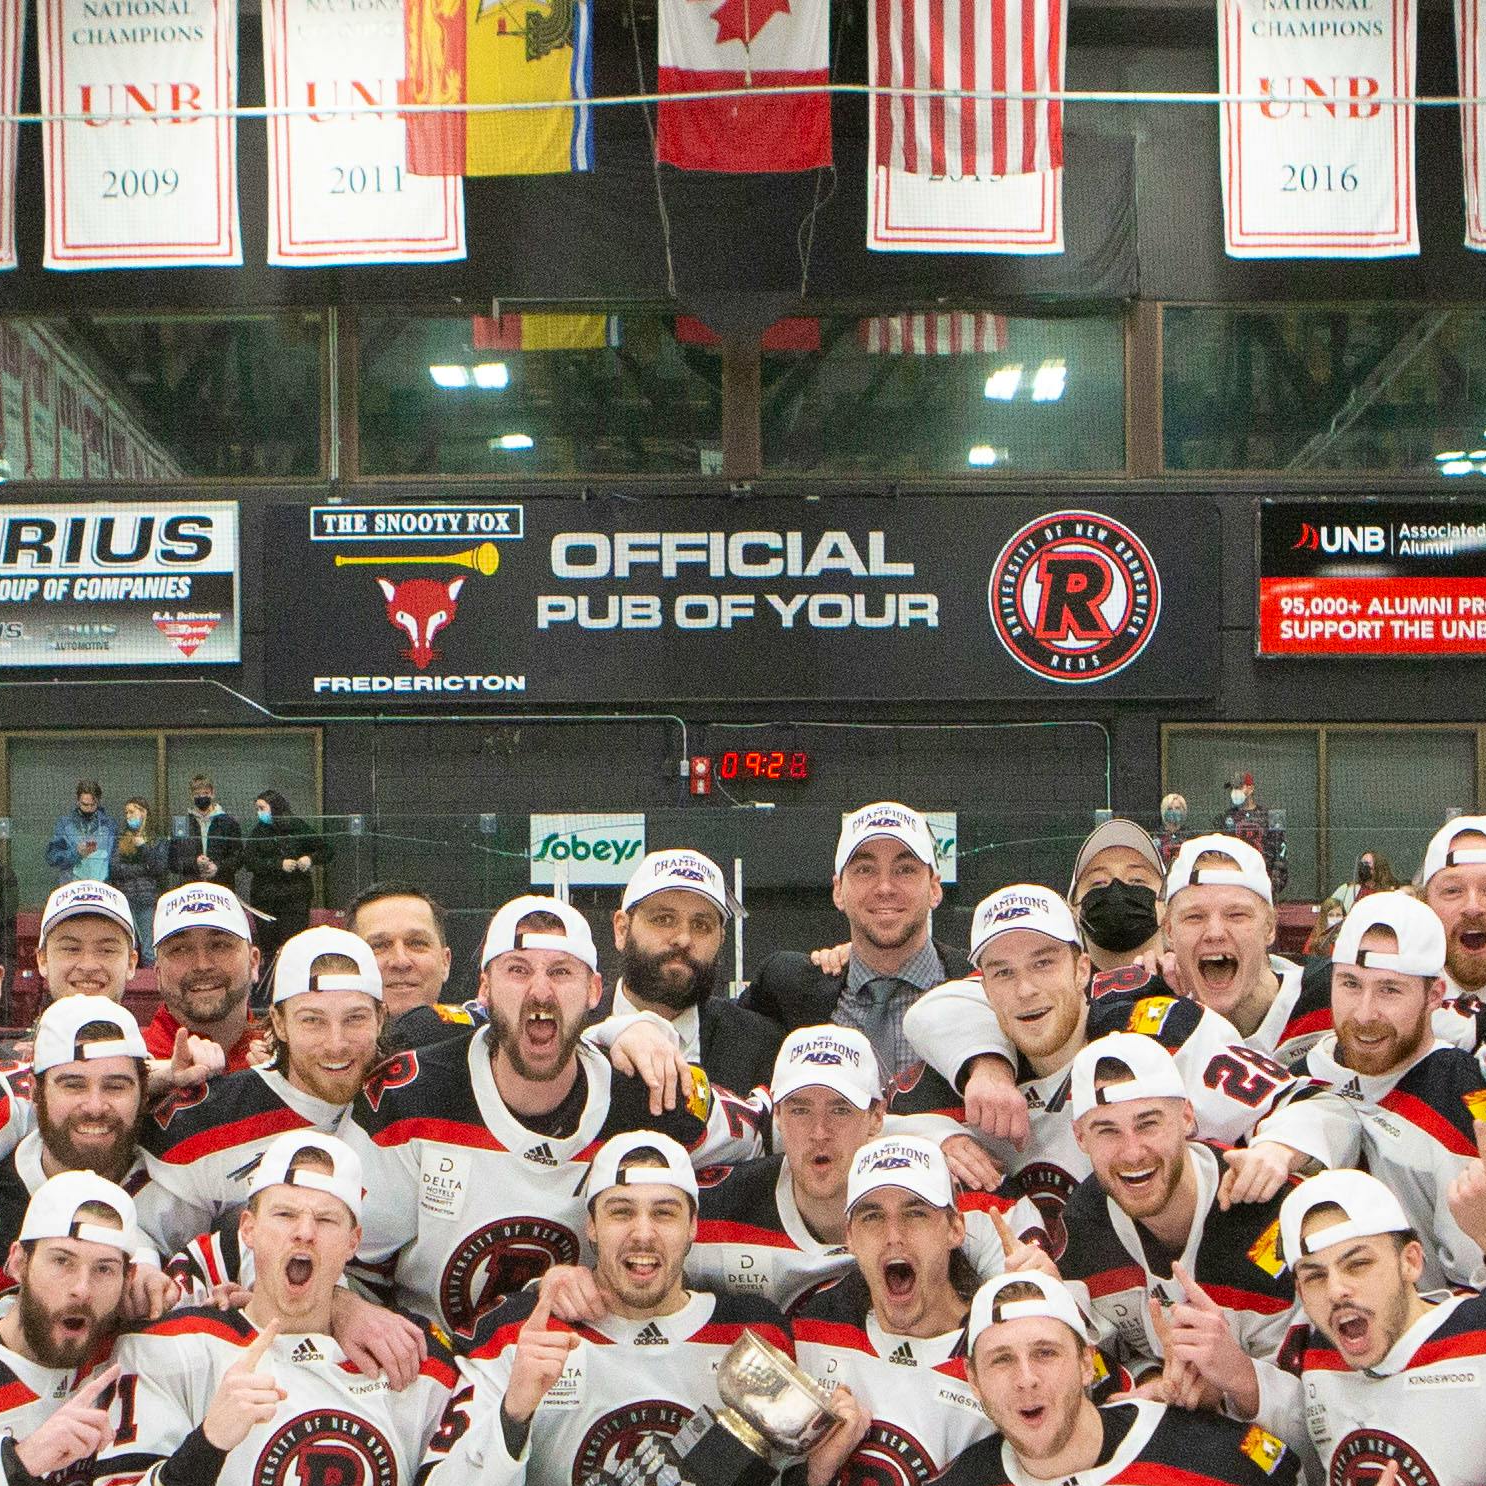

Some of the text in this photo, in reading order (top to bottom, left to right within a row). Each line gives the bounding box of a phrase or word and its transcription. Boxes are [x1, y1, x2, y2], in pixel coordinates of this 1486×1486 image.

[82, 0, 197, 19] NATIONAL
[71, 26, 205, 46] CHAMPIONS
[1251, 18, 1384, 37] CHAMPIONS
[77, 82, 203, 128] UNB
[1258, 75, 1382, 120] UNB
[102, 168, 181, 199] 2009
[329, 166, 405, 195] 2011
[1280, 163, 1359, 192] 2016
[322, 512, 511, 534] THE SNOOTY FOX
[1320, 522, 1486, 553] UNB Associated
[1398, 539, 1455, 556] Alumni
[550, 531, 915, 579] OFFICIAL
[43, 578, 70, 601] OF
[72, 576, 193, 601] COMPANIES
[1002, 522, 1148, 639] UNIVERSITY OF NEW BRUNSWICK
[536, 593, 940, 630] PUB OF YOUR
[1280, 597, 1361, 617] 95,000+
[1367, 597, 1452, 616] ALUMNI
[1280, 620, 1384, 640] SUPPORT
[1390, 620, 1435, 640] THE
[1050, 653, 1102, 671] REDS
[313, 675, 527, 694] FREDERICTON
[534, 832, 644, 865] Sobeys
[165, 892, 232, 917] CHAMPIONS
[789, 1040, 861, 1069] CHAMPIONS
[856, 1147, 931, 1176] CHAMPIONS
[422, 1172, 463, 1191] DELTA
[728, 1273, 770, 1284] DELTA
[1407, 1372, 1476, 1385] KINGSWOOD
